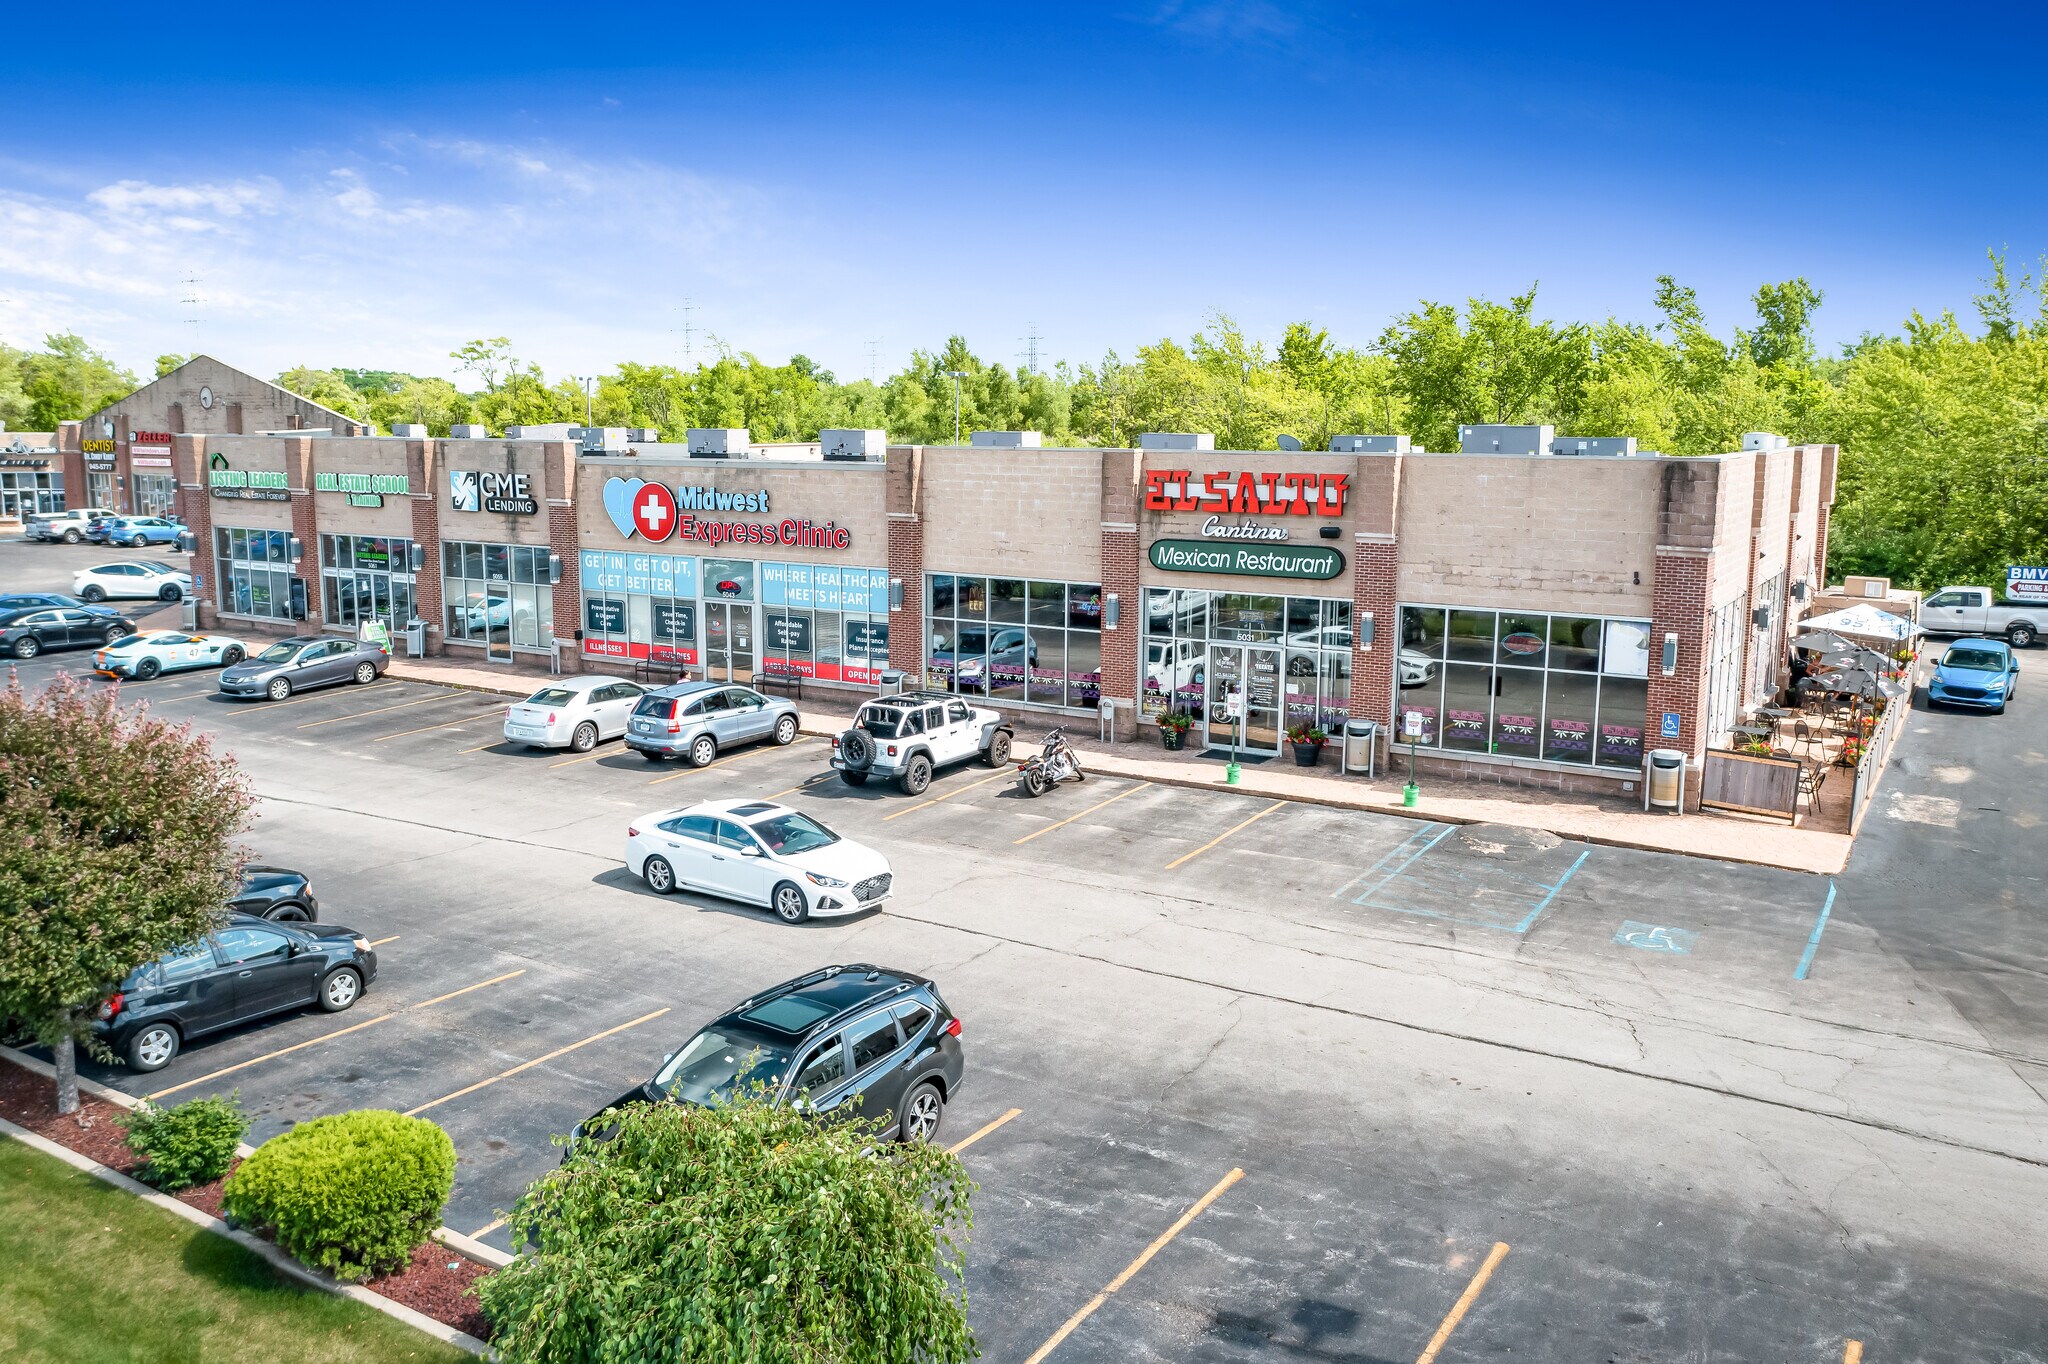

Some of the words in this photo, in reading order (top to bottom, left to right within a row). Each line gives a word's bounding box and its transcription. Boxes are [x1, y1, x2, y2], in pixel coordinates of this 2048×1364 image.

[137, 432, 169, 443] ZELLER
[82, 440, 115, 452] DENTIST
[210, 471, 247, 487] LISTING
[248, 472, 288, 488] LEADERS
[316, 473, 338, 491] REAL
[338, 474, 371, 493] ESTATE
[372, 475, 408, 494] SCHOOL
[480, 473, 529, 498] CME
[346, 494, 351, 504] &
[352, 494, 381, 507] TRAINING
[678, 487, 768, 512] Midwest
[1145, 470, 1198, 511] EL
[1202, 472, 1350, 516] SALTO
[488, 500, 532, 512] LENDING
[679, 515, 776, 547] Express
[778, 519, 849, 549] Clinic
[1201, 516, 1288, 540] Cantina
[585, 555, 608, 568] GET
[634, 558, 658, 572] GET
[662, 560, 690, 577] OUT,
[1158, 547, 1230, 568] Mexican
[1236, 551, 1333, 574] Restaurant
[598, 574, 621, 587] GET
[627, 576, 678, 592] BETTER.
[764, 569, 807, 583] WHERE
[784, 588, 826, 602] MEETS
[829, 592, 872, 606] HEART
[778, 629, 800, 638] Sel-pay
[856, 636, 884, 644] Insurance
[1237, 634, 1254, 642] 5031
[190, 649, 198, 657] 47
[590, 642, 622, 652] ILLNESSES
[848, 670, 868, 680] OPEN
